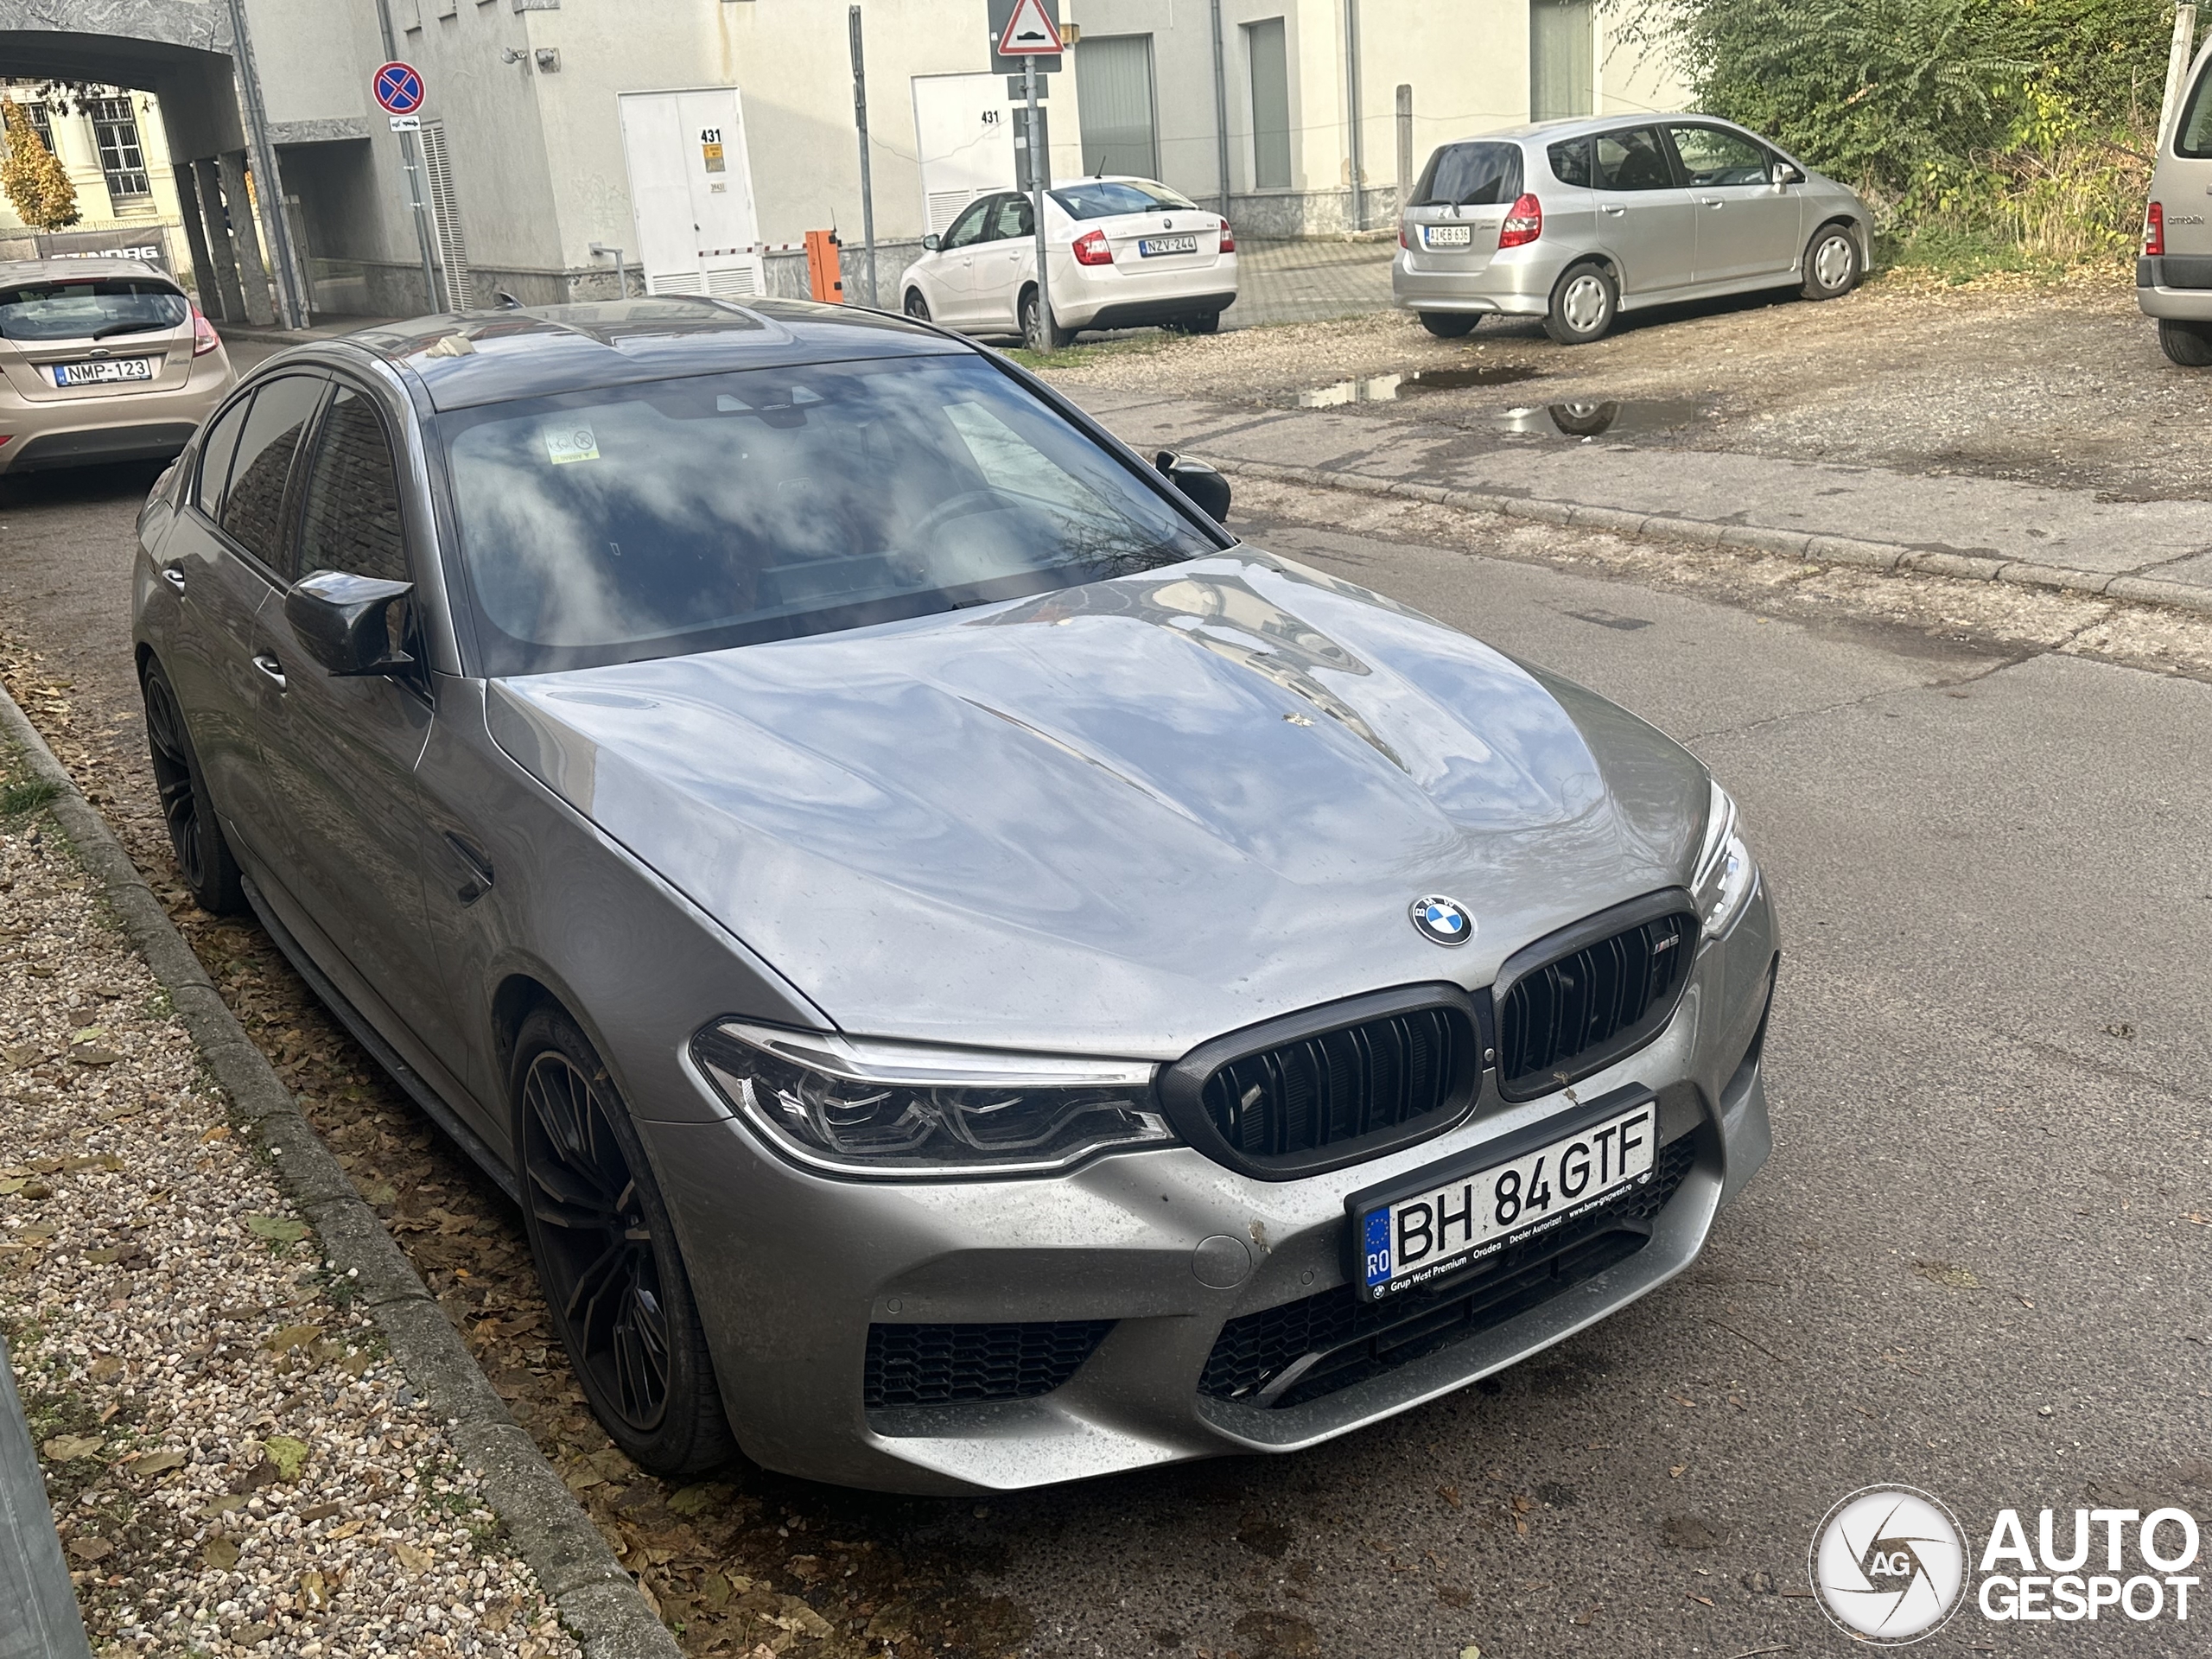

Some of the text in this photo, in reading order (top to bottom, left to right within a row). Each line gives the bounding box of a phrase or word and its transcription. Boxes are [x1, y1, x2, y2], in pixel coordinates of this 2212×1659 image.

[982, 110, 999, 124] 431
[701, 129, 721, 143] 431
[2168, 214, 2205, 225] CITROËN
[1147, 236, 1194, 251] NZV-244
[68, 361, 146, 380] NMP-123
[1414, 897, 1455, 918] BMW
[1397, 1184, 1472, 1267] BH
[1390, 1278, 1411, 1292] Grup
[1412, 1270, 1432, 1283] West
[1433, 1256, 1467, 1276] Premium
[1473, 1242, 1502, 1259] Oradea
[1510, 1230, 1532, 1244] Dealer
[1532, 1215, 1563, 1236] Autorizat
[1367, 1249, 1389, 1278] RO
